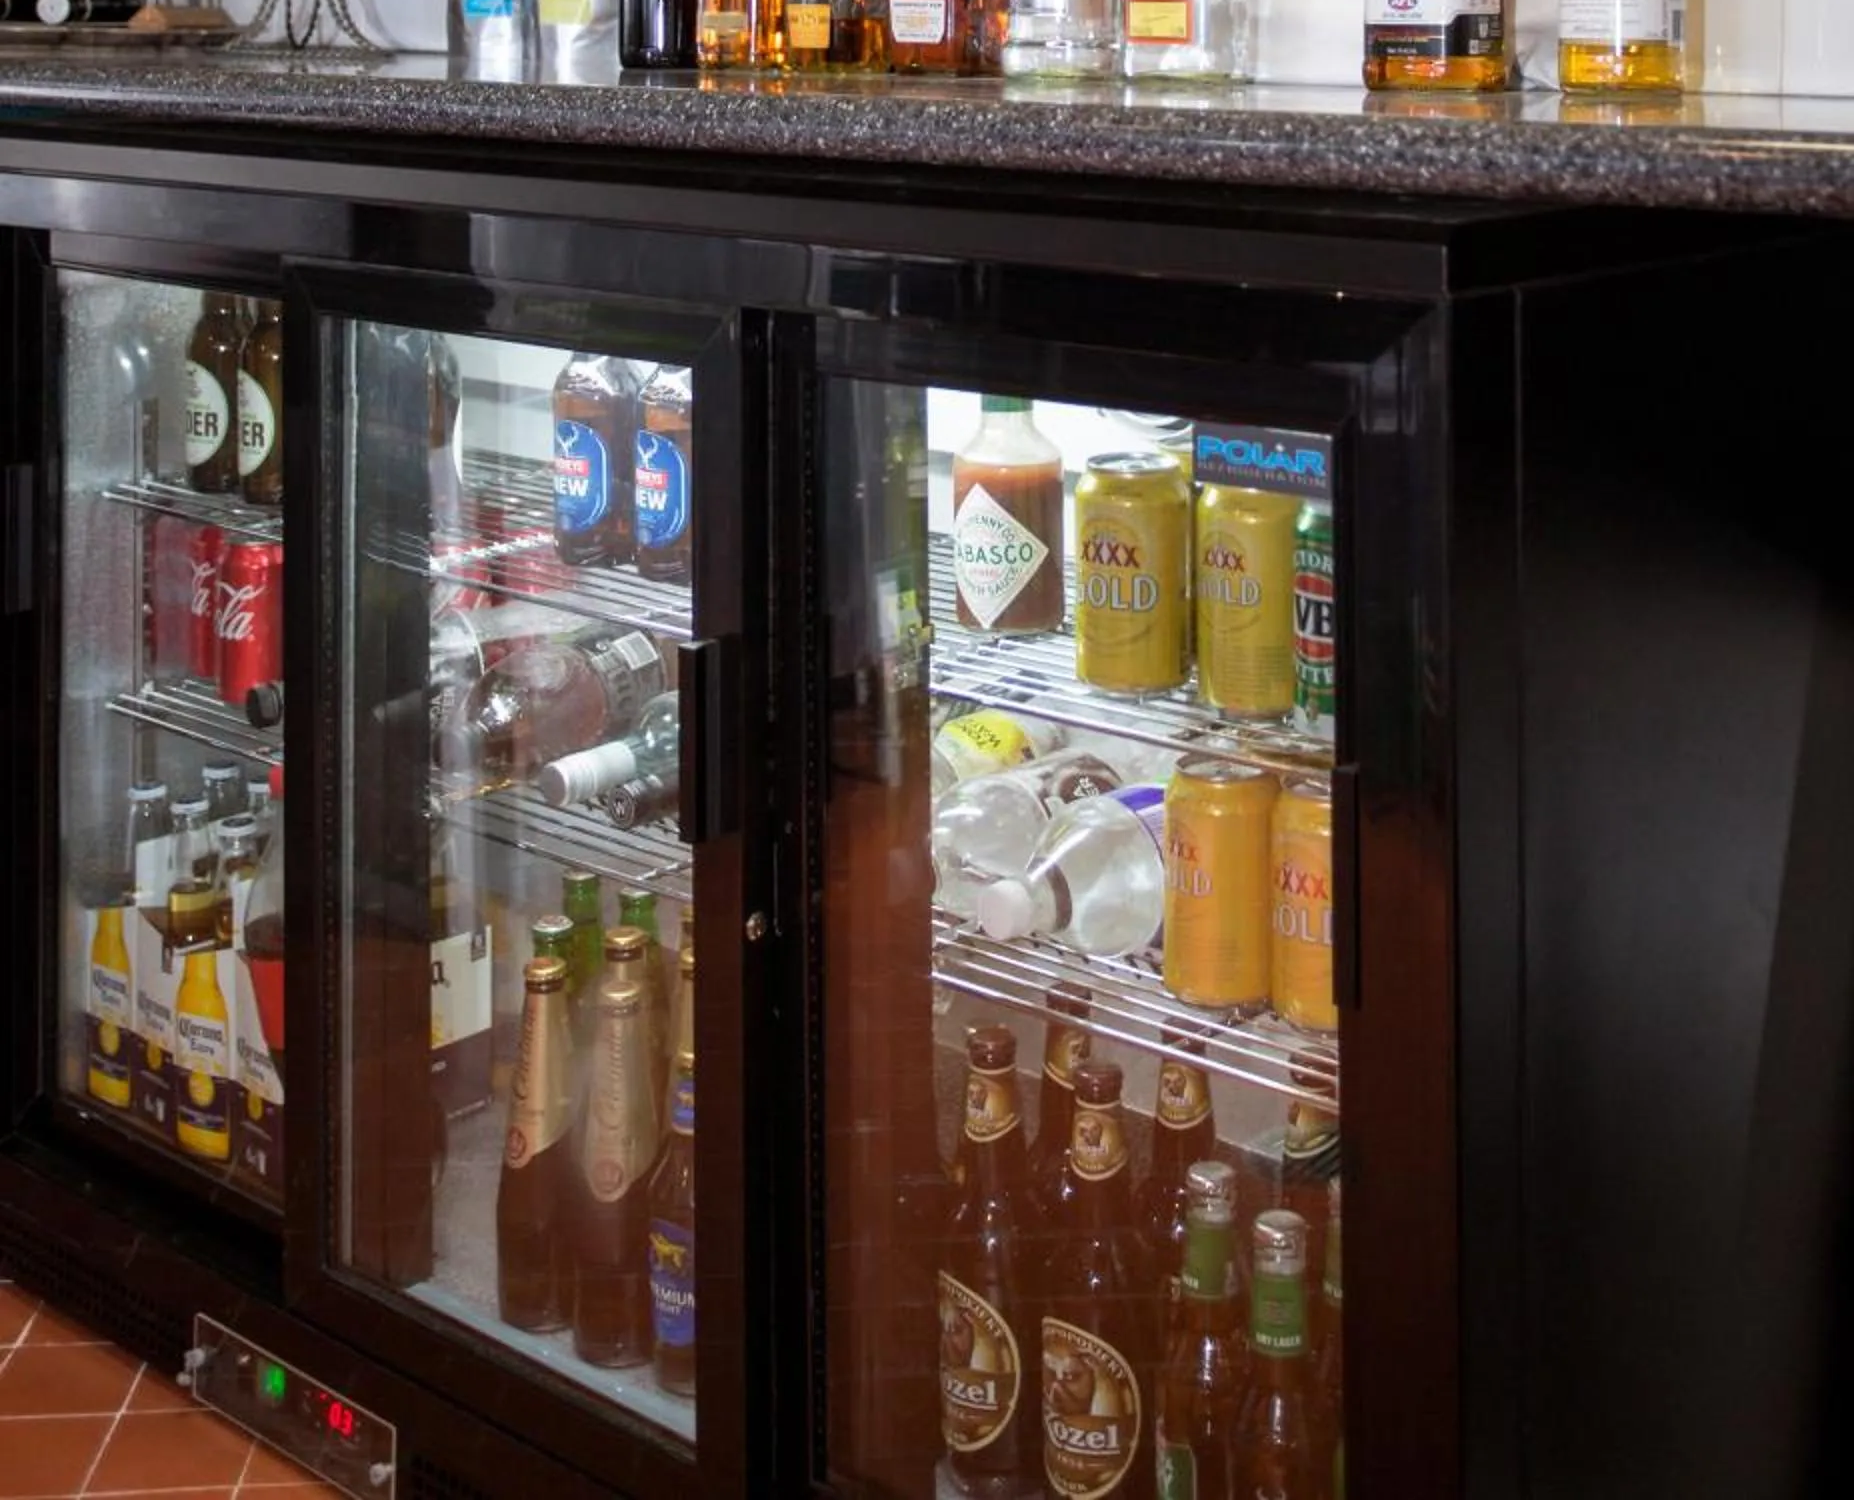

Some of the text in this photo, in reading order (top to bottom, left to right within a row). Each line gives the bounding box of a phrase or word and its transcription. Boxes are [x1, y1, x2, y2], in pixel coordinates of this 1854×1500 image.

[185, 410, 219, 437] DER
[242, 420, 265, 447] ER
[1197, 435, 1326, 477] POLAR
[636, 485, 667, 511] EW
[958, 542, 1034, 565] ABASCO
[179, 1017, 223, 1042] Corona
